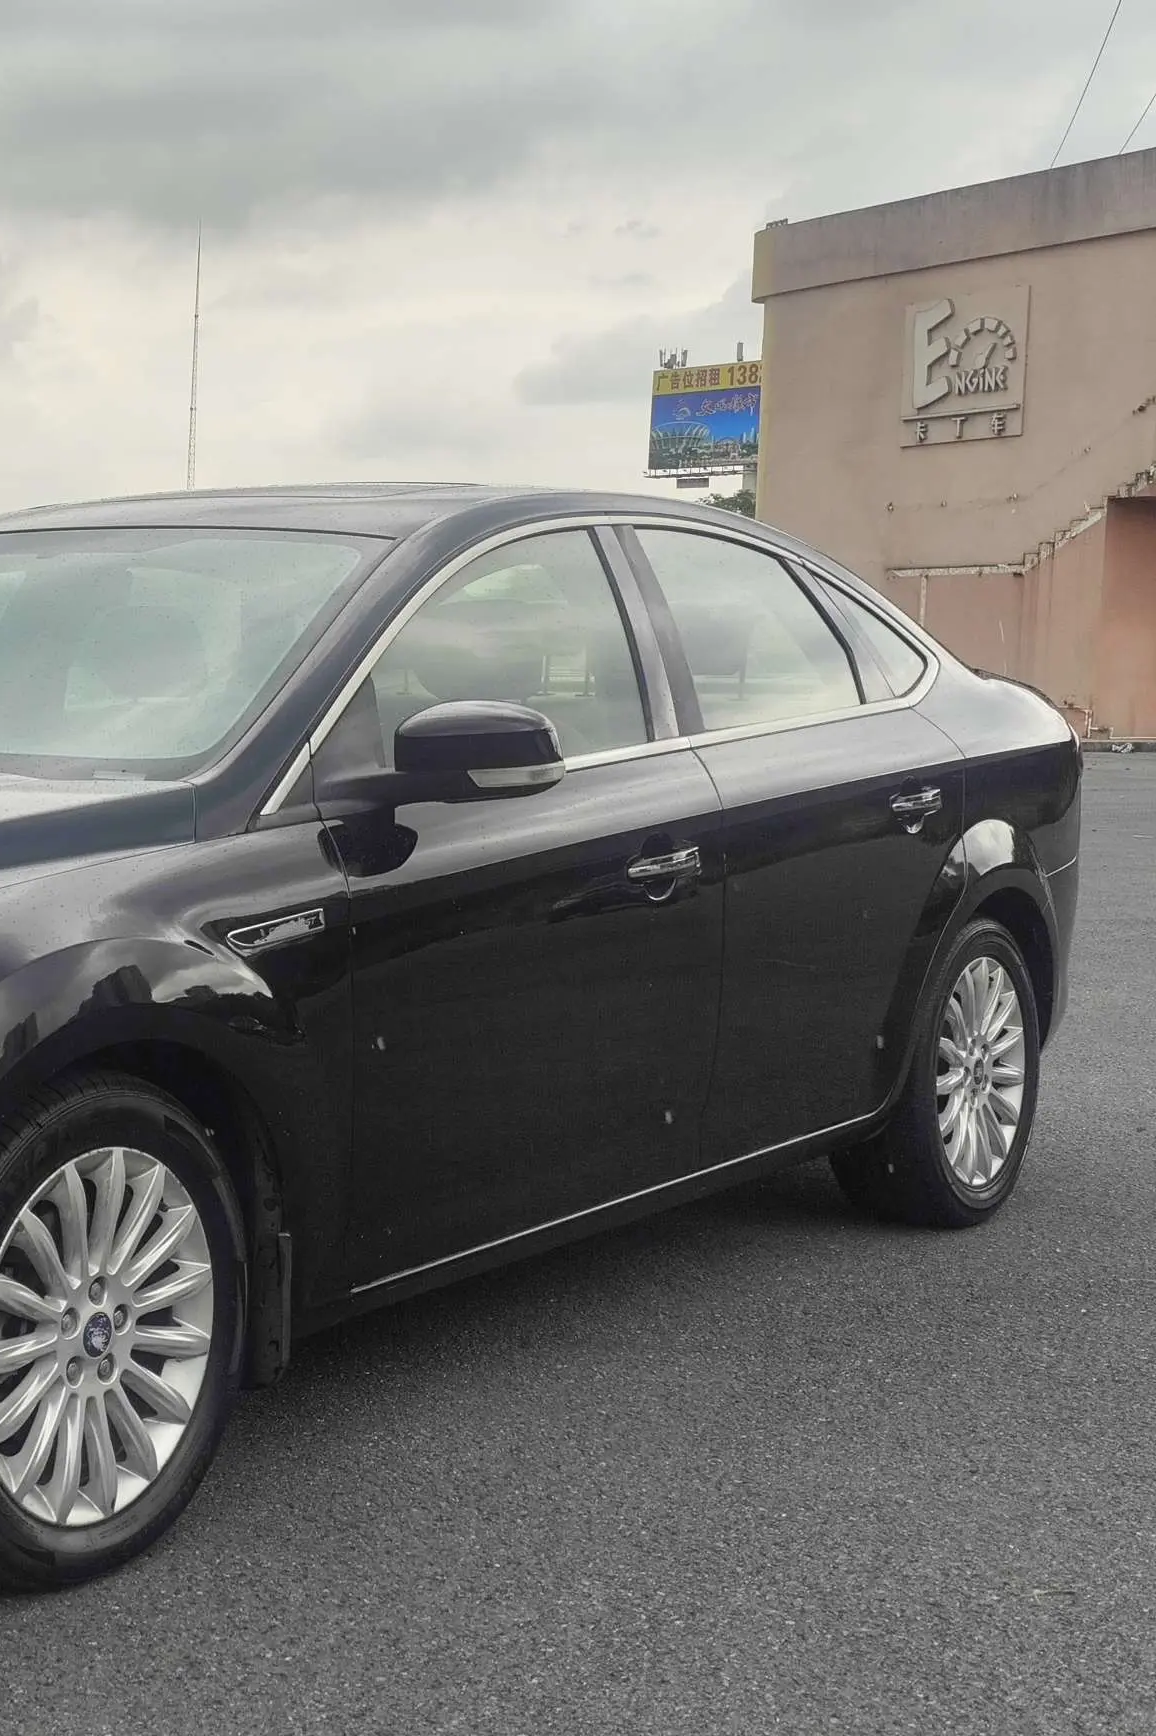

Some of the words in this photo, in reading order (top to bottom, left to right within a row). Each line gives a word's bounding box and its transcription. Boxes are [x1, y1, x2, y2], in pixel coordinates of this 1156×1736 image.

[656, 367, 721, 391] 广告位招租
[727, 364, 762, 386] 138
